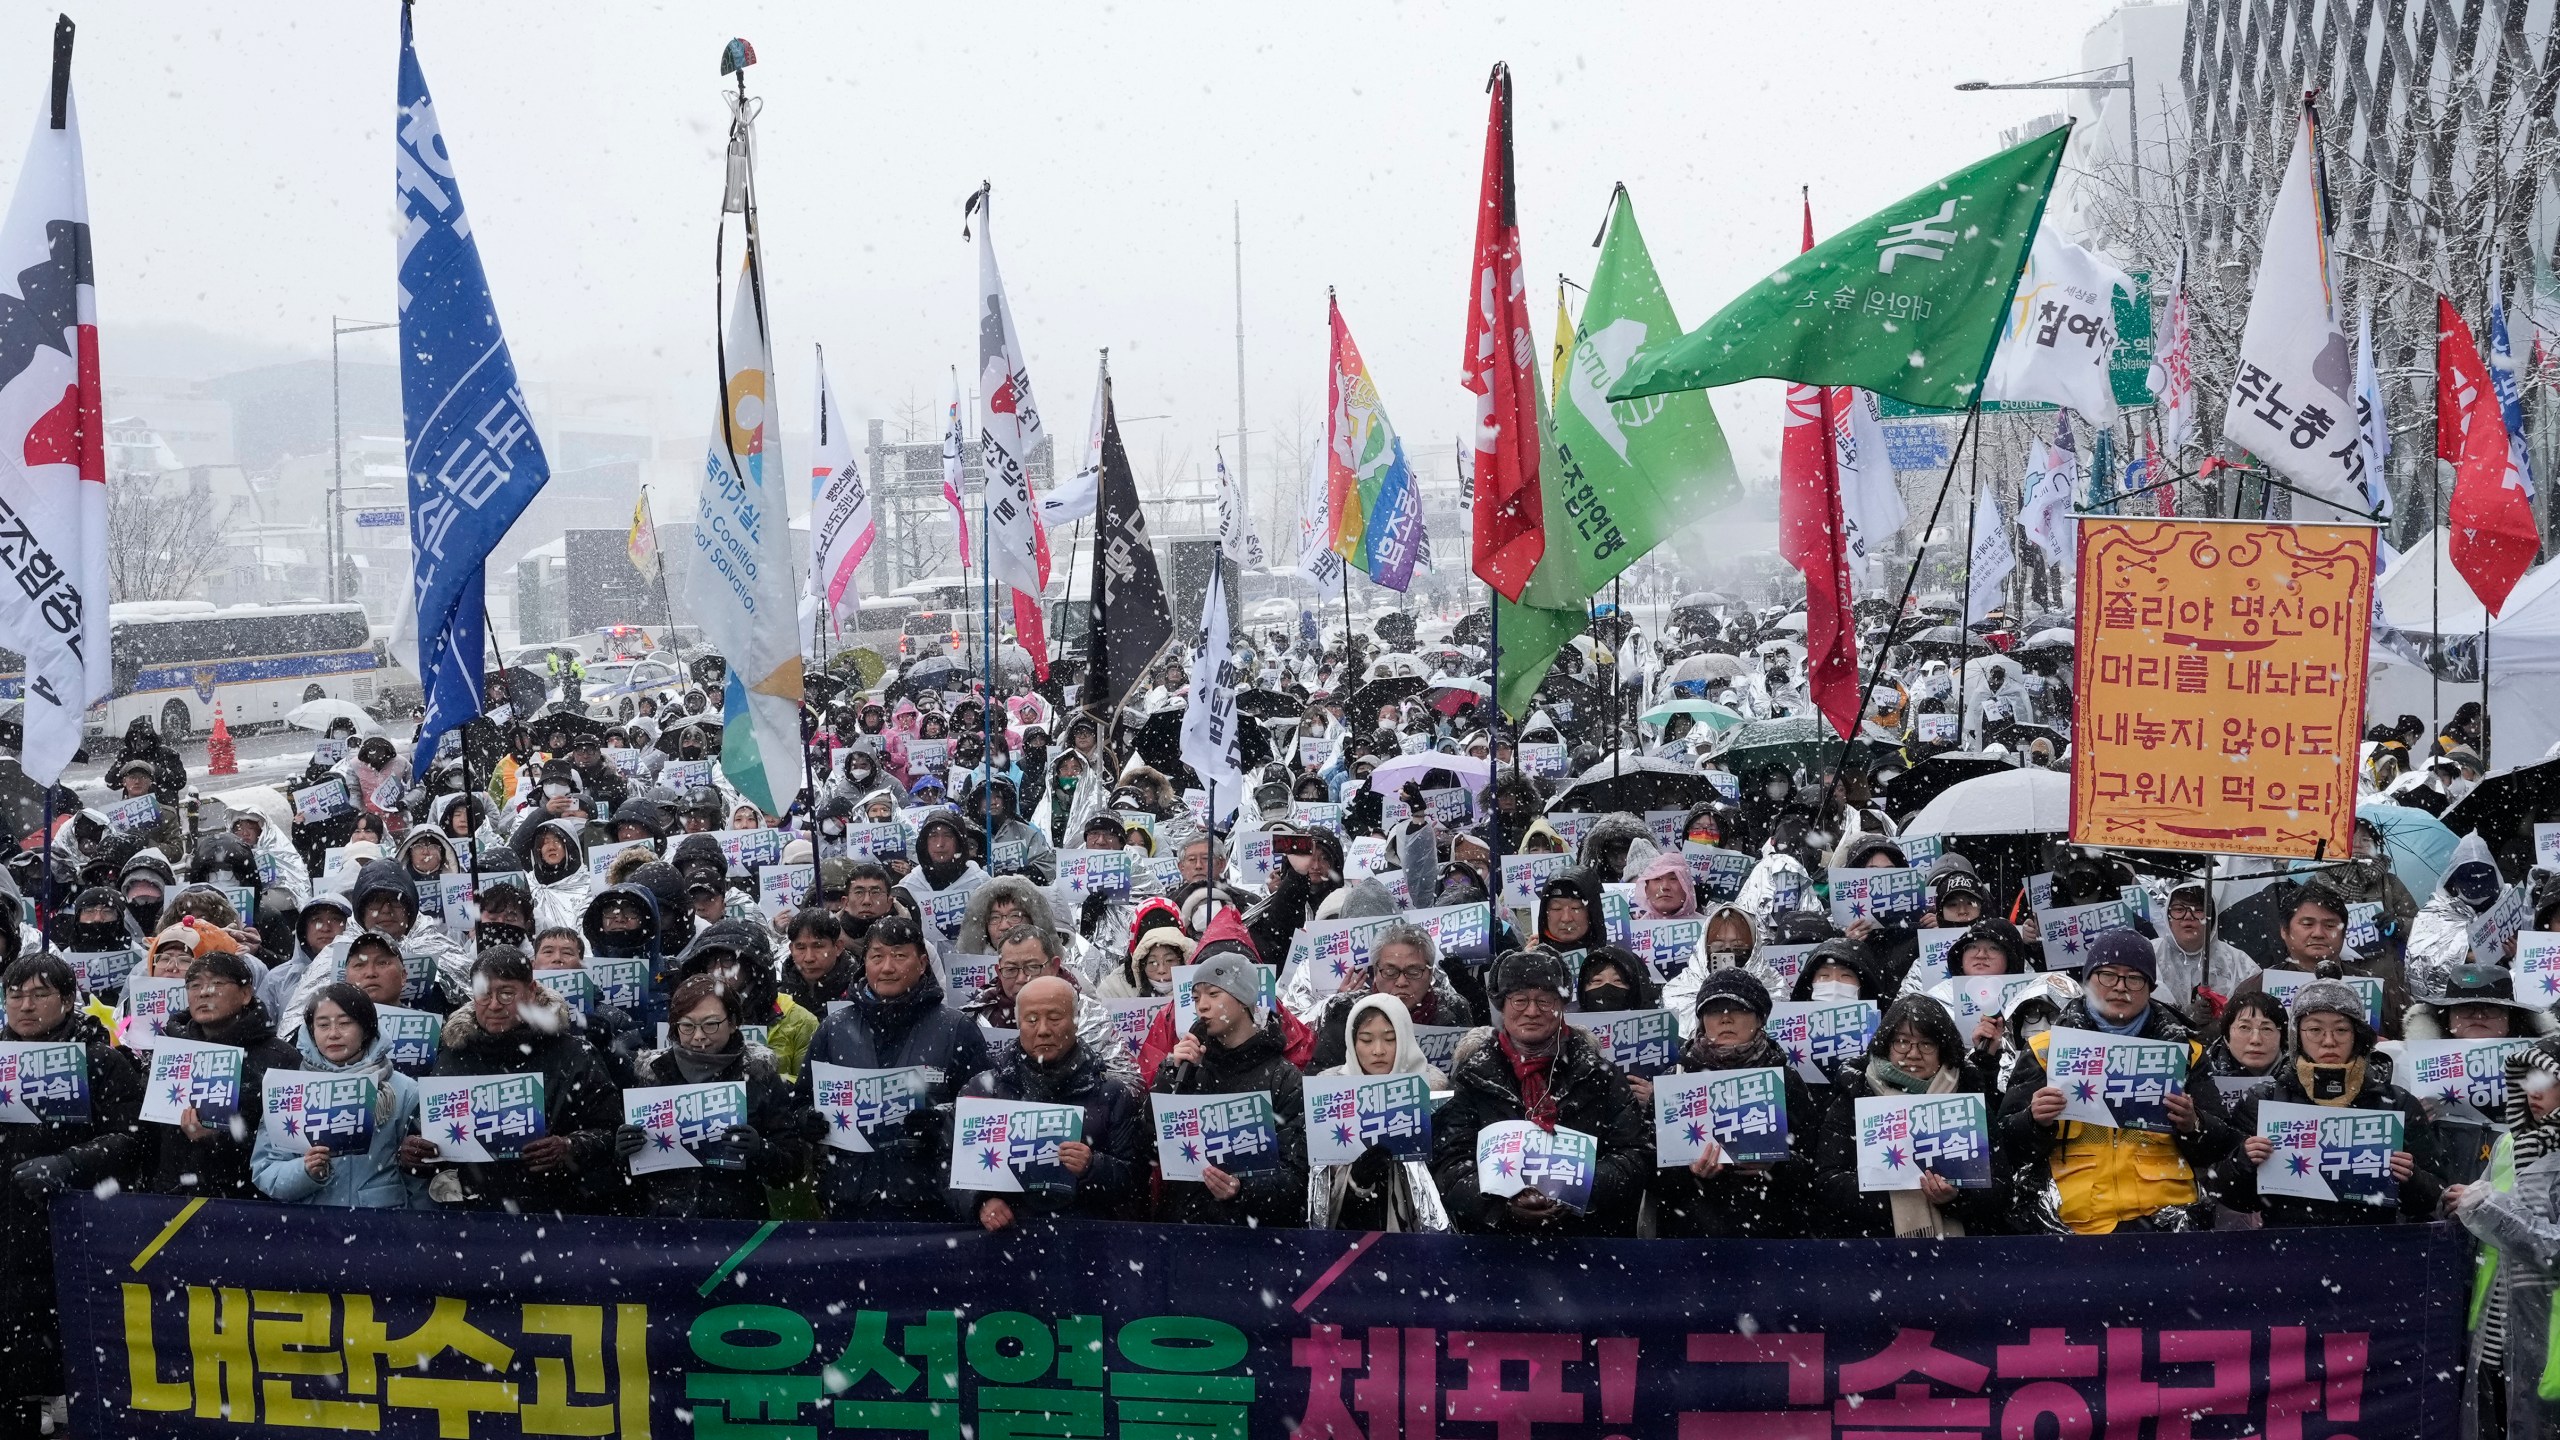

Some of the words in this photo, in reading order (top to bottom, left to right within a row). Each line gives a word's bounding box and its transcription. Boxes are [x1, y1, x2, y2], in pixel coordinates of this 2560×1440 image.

[2064, 286, 2098, 305] 세상을
[2113, 337, 2151, 357] 수역
[2235, 358, 2336, 450] 주노총
[2104, 590, 2214, 631] 쥴리야
[2231, 595, 2340, 635] 명신아
[324, 658, 349, 669] POLICE
[2101, 654, 2208, 693] 머리를
[2228, 660, 2338, 696] 내놔라
[2097, 712, 2203, 750] 내놓지
[2223, 718, 2332, 755] 않아도
[924, 745, 947, 757] 체포!
[924, 754, 945, 766] 구속!
[1535, 745, 1563, 760] 체포!
[683, 762, 711, 777] 체포!
[1536, 759, 1562, 774] 구속!
[316, 781, 344, 801] 체포!
[685, 774, 709, 789] 구속!
[319, 794, 346, 812] 구속!
[1436, 790, 1464, 808] 해체
[2097, 772, 2203, 807] 구워서
[2222, 776, 2331, 815] 먹으리
[125, 795, 156, 815] 체포!
[1439, 806, 1466, 822] 하라
[129, 811, 157, 827] 구속!
[740, 831, 774, 852] 체포!
[871, 826, 900, 842] 체포!
[743, 849, 775, 866] 구속!
[873, 840, 900, 857] 구속!
[992, 842, 1025, 862] 체포!
[1245, 848, 1271, 861] 윤석열
[1060, 865, 1085, 877] 윤석열
[1087, 854, 1124, 874] 체포!
[1505, 863, 1531, 873] 내란수괴
[763, 874, 789, 884] 내란동조
[764, 881, 789, 891] 국민의힘
[1087, 873, 1124, 891] 구속!
[1507, 870, 1532, 884] 윤석열
[1833, 878, 1868, 891] 내란수괴
[1869, 870, 1921, 898] 체포!
[446, 884, 473, 895] 내란수괴
[447, 892, 474, 905] 윤석열
[1835, 887, 1868, 900] 윤석열
[1872, 892, 1919, 918] 구속!
[1440, 905, 1483, 933] 체포!
[2079, 907, 2126, 932] 체포!
[1314, 930, 1349, 946] 내란수괴
[1439, 927, 1482, 952] 구속!
[1652, 924, 1697, 947] 체포!
[1315, 942, 1349, 959] 윤석열
[88, 954, 135, 977] 체포!
[951, 967, 986, 976] 내란수괴
[952, 975, 986, 989] 윤석열
[136, 989, 166, 1004] 내란수괴
[137, 1000, 166, 1017] 윤석열
[1613, 1014, 1669, 1046] 체포!
[1766, 1015, 1806, 1031] 내란수괴
[1809, 1004, 1869, 1039] 체포!
[19, 1047, 77, 1078] 체포!
[157, 1053, 193, 1068] 내란수괴
[1616, 1045, 1669, 1072] 구속!
[2056, 1046, 2106, 1060] 내란수괴
[2107, 1045, 2177, 1077] 체포!
[2415, 1052, 2463, 1071] 내란동조
[156, 1064, 190, 1082] 윤석열
[192, 1047, 240, 1082] 체포!
[2055, 1058, 2104, 1076] 윤석열
[2416, 1064, 2464, 1084] 국민의힘
[20, 1079, 79, 1105] 구속!
[190, 1080, 233, 1108] 구속!
[267, 1084, 304, 1101] 내란수괴
[304, 1077, 368, 1110] 체포!
[470, 1075, 534, 1115] 체포!
[818, 1079, 853, 1093] 내란수괴
[1357, 1077, 1420, 1114] 체포!
[1710, 1072, 1779, 1111] 체포!
[2104, 1078, 2174, 1107] 구속!
[268, 1097, 303, 1114] 윤석열
[427, 1089, 469, 1106] 내란수괴
[677, 1086, 737, 1124] 체포!
[819, 1090, 853, 1108] 윤석열
[1312, 1090, 1355, 1108] 내란수괴
[427, 1104, 470, 1121] 윤석열
[631, 1099, 673, 1118] 내란수괴
[1160, 1110, 1198, 1125] 내란수괴
[1200, 1095, 1264, 1132] 체포!
[1312, 1103, 1355, 1123] 윤석열
[1664, 1100, 1708, 1123] 윤석열
[1910, 1099, 1976, 1135] 체포!
[304, 1109, 365, 1144] 구속!
[472, 1112, 535, 1142] 구속!
[963, 1113, 1007, 1130] 내란수괴
[1009, 1107, 1074, 1142] 체포!
[1360, 1108, 1421, 1146] 구속!
[1714, 1109, 1777, 1141] 구속!
[1863, 1110, 1907, 1128] 내란수괴
[2266, 1120, 2318, 1134] 내란수괴
[962, 1127, 1007, 1146] 윤석열
[1162, 1122, 1198, 1140] 윤석열
[1863, 1123, 1908, 1146] 윤석열
[2320, 1116, 2392, 1150] 체포!
[1205, 1131, 1269, 1165] 구속!
[1479, 1139, 1520, 1163] 윤석열
[1480, 1130, 1520, 1153] 내란수괴
[1523, 1131, 1587, 1158] 체포!
[1913, 1132, 1978, 1166] 구속!
[2266, 1132, 2317, 1151] 윤석열
[1523, 1157, 1584, 1187] 구속!
[2319, 1150, 2391, 1181] 구속!
[120, 1282, 652, 1440] 내란수괴
[685, 1302, 1256, 1440] 윤석열을
[1289, 1322, 1641, 1440] 체포!
[1678, 1327, 2371, 1440] 구속하라!
